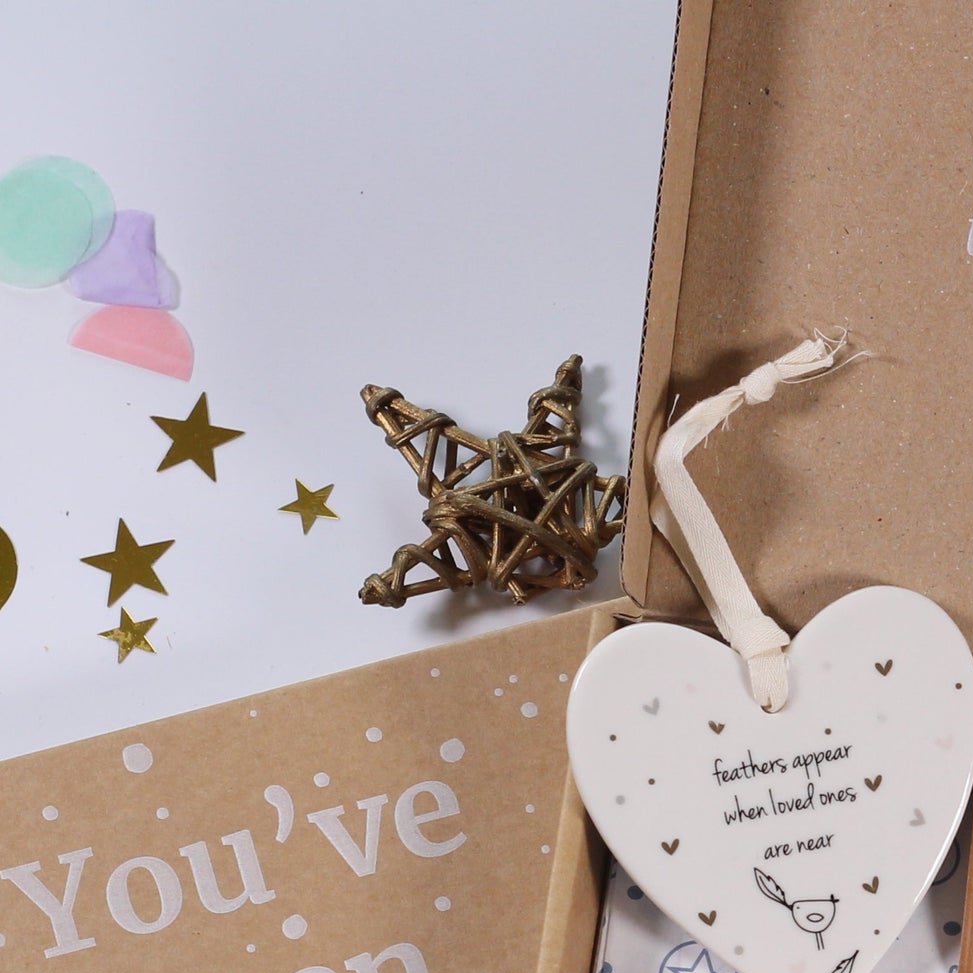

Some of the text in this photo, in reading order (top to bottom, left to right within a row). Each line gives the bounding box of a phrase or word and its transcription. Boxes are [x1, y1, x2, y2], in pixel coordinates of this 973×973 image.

[712, 744, 853, 786] feathers appear
[724, 783, 857, 826] when loved ones
[764, 832, 835, 860] are near
